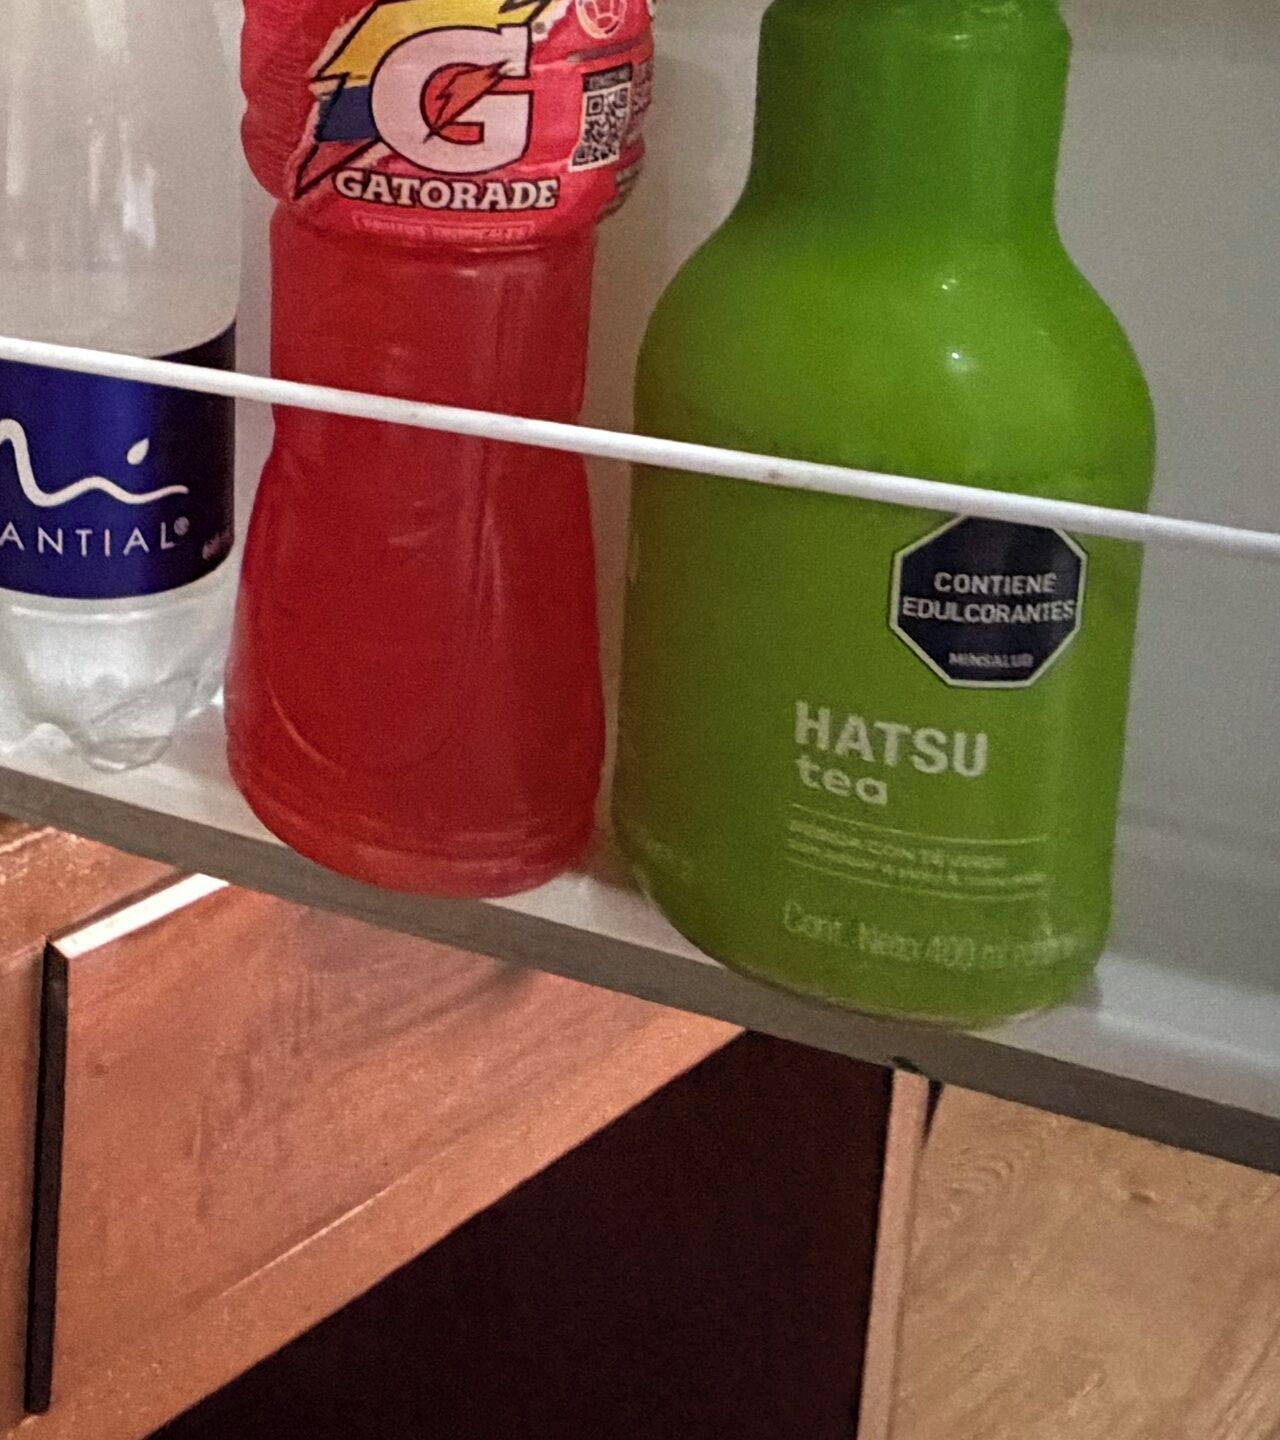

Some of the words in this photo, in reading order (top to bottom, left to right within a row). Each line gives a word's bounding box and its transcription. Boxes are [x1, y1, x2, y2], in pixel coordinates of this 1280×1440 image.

[368, 22, 535, 175] G
[333, 168, 561, 212] GATORADE
[933, 571, 1059, 595] CONTIENE
[902, 596, 1076, 625] EDULCORANTES
[948, 652, 1035, 669] MINSALUD
[793, 699, 989, 778] HATSU
[796, 757, 889, 806] tea
